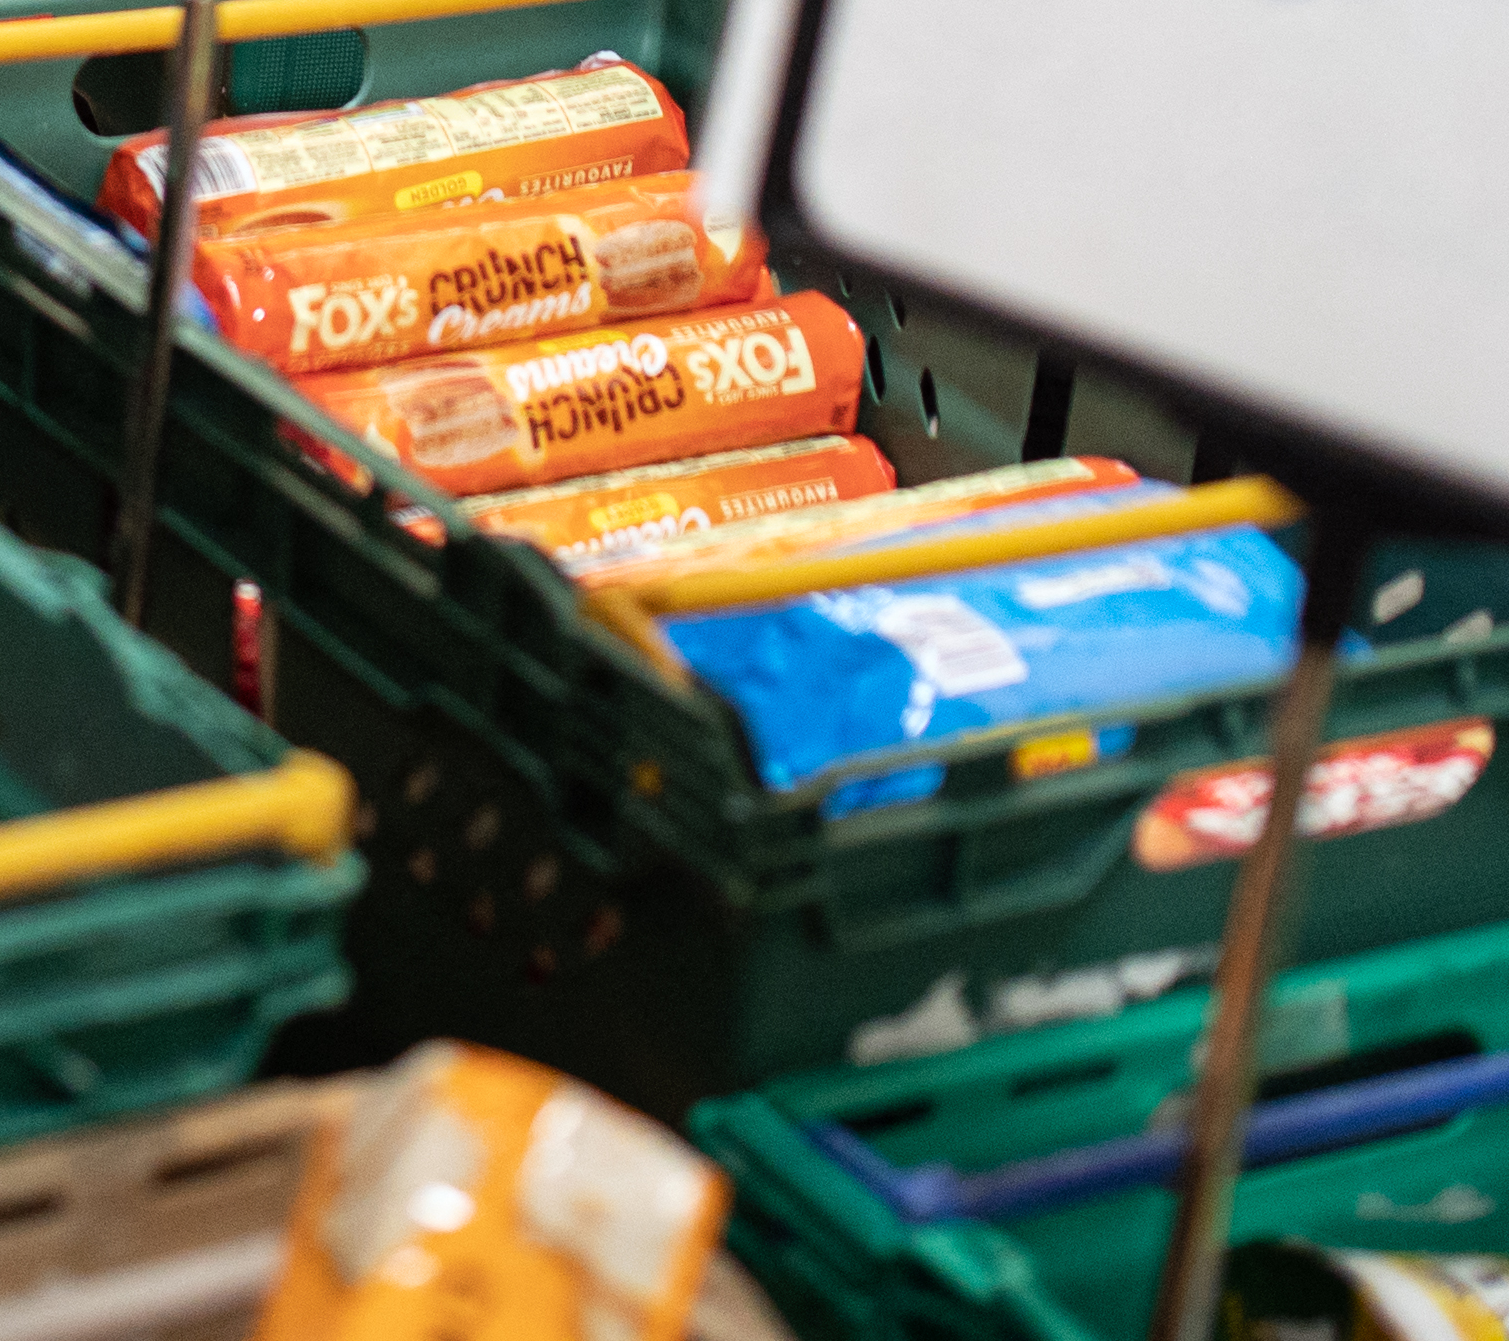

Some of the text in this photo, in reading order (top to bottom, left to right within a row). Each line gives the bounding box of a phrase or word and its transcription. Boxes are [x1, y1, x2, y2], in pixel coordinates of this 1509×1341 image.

[411, 176, 469, 204] GOLDEN
[519, 158, 633, 196] FAVOURITES
[429, 235, 589, 316] CRUNCH
[428, 281, 592, 345] Creams
[505, 332, 669, 403] Creams
[525, 362, 686, 450] CRUNCH
[719, 479, 839, 521] FAVOURITES
